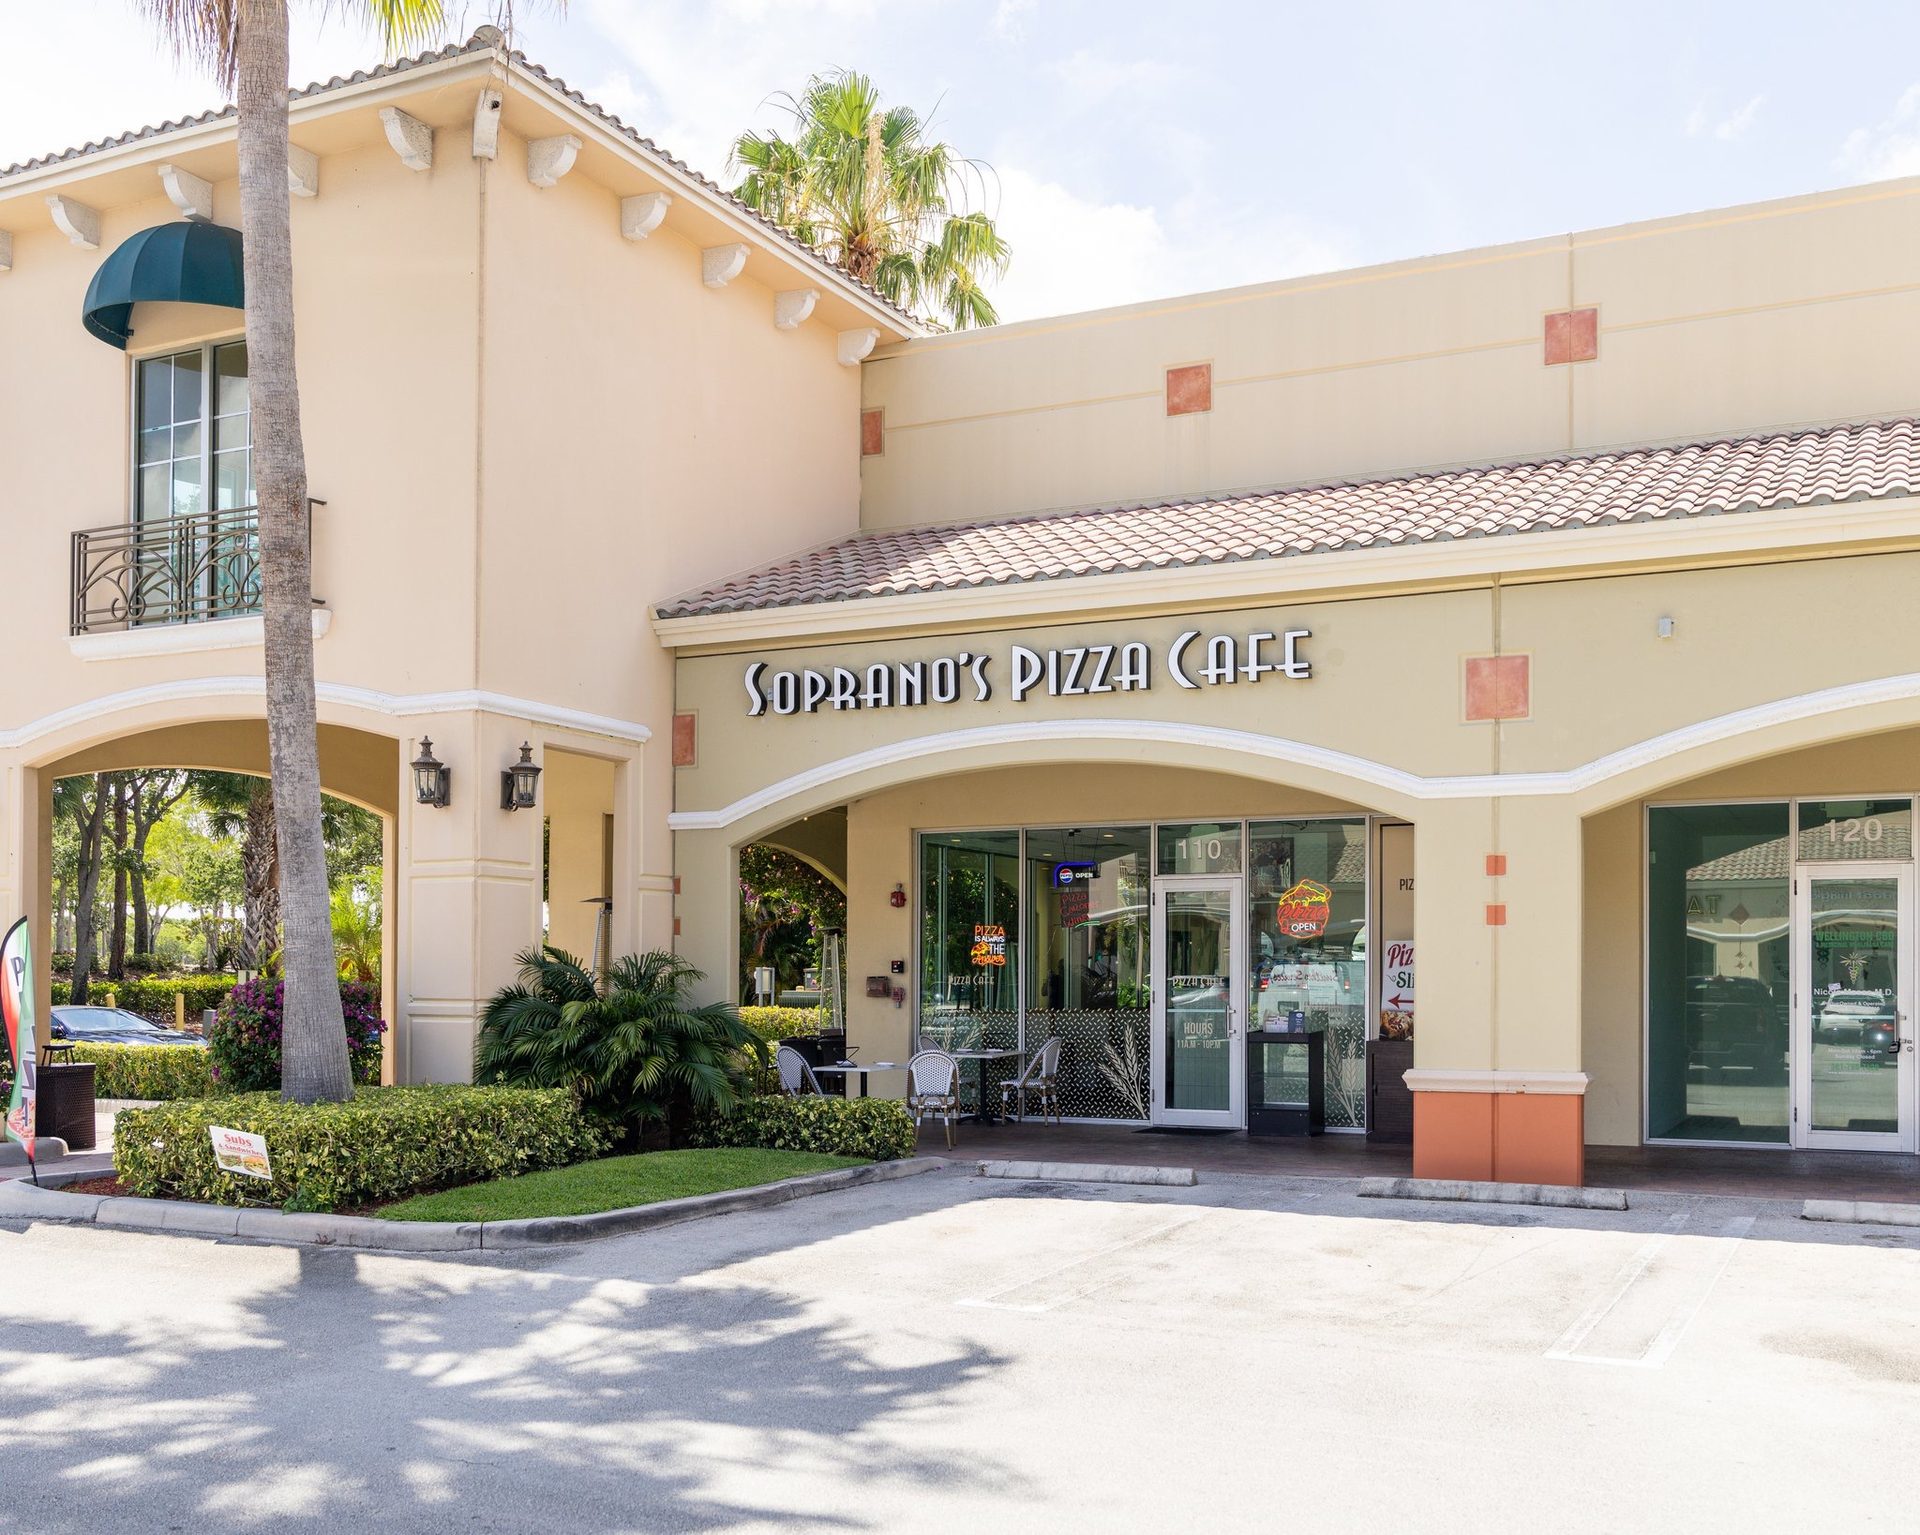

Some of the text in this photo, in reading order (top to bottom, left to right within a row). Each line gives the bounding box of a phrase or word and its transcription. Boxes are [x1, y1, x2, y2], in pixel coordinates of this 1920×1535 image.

[744, 630, 1312, 716] SOPRANO'S PIZZA CAFE
[1825, 818, 1882, 842] 120
[1178, 839, 1222, 859] 110
[974, 925, 1005, 936] PIZZA
[1291, 922, 1316, 932] OPEN
[989, 943, 1005, 955] THE
[948, 973, 995, 985] PIZZA CAFE
[1172, 976, 1225, 988] PIZZA CAFE
[1183, 1022, 1213, 1035] HOURS
[223, 1133, 253, 1147] Subs
